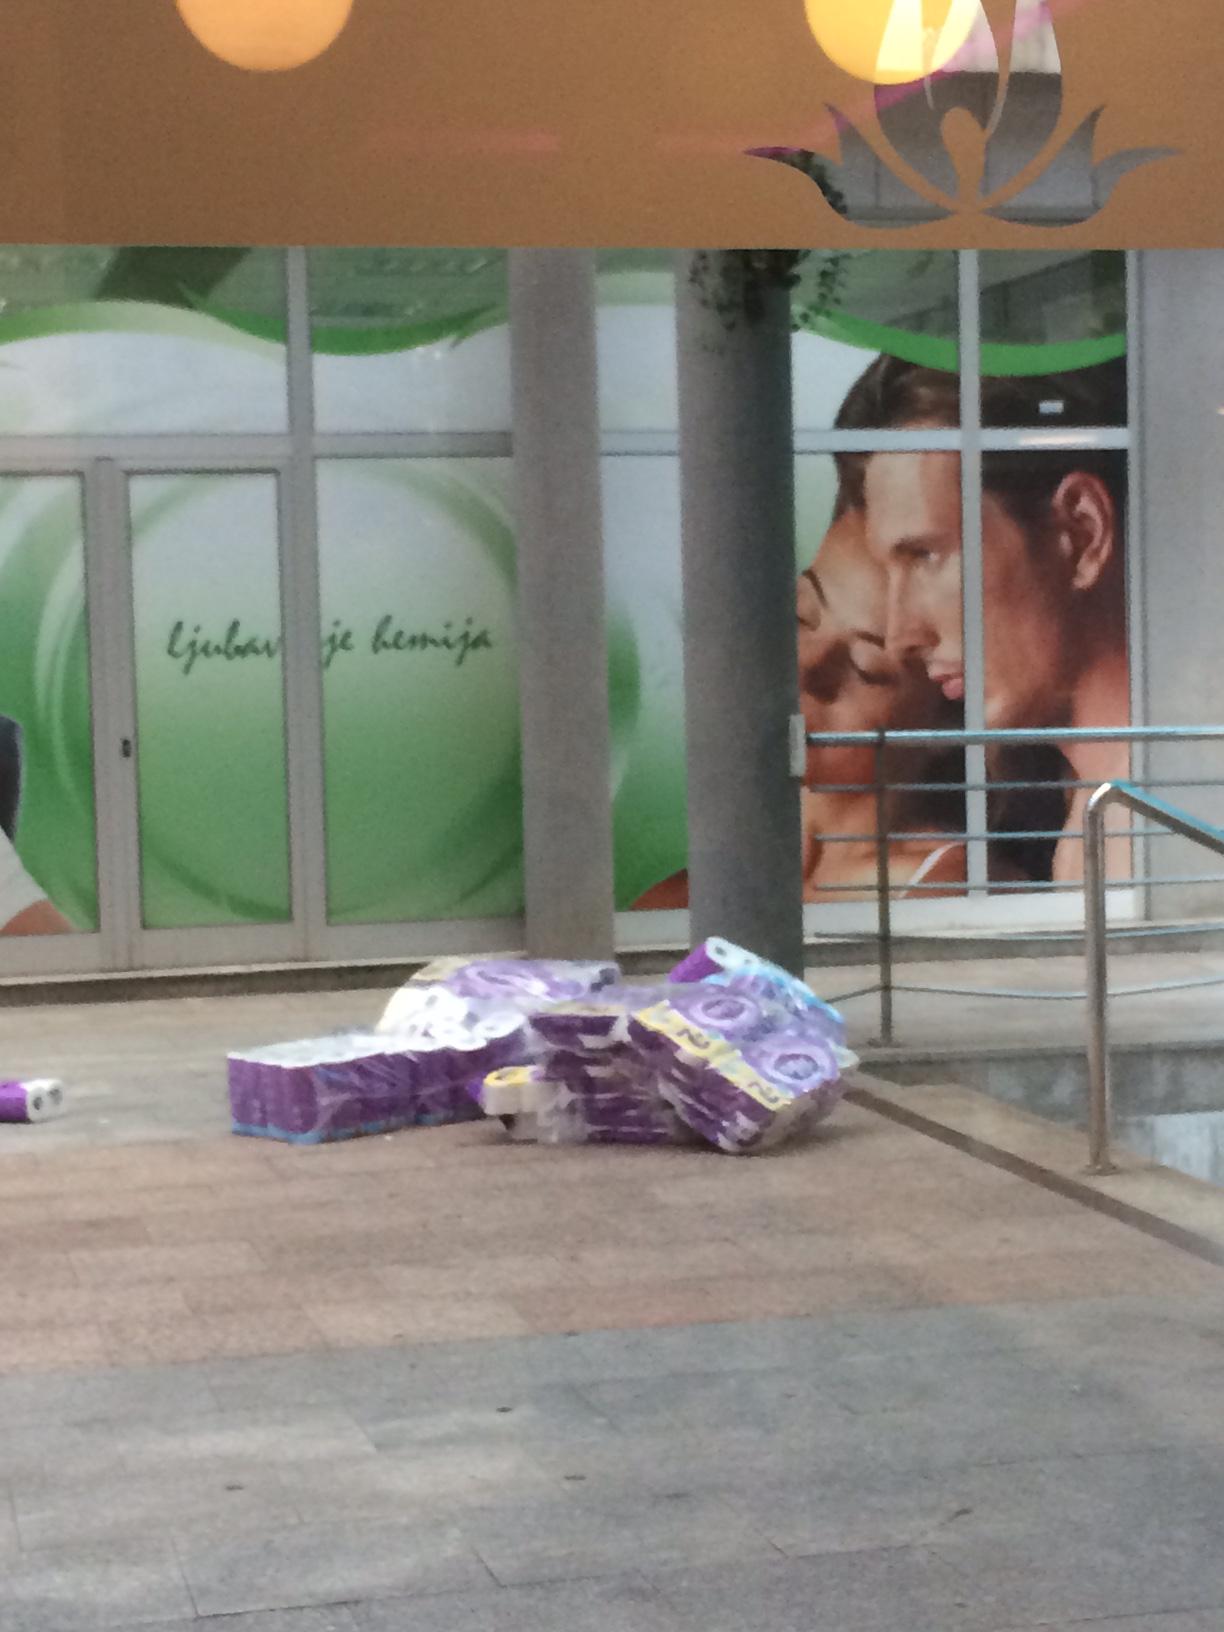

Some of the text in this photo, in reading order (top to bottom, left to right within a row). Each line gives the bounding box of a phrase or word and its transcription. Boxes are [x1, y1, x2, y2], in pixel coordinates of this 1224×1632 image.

[167, 614, 492, 676] ljubav je hemija
